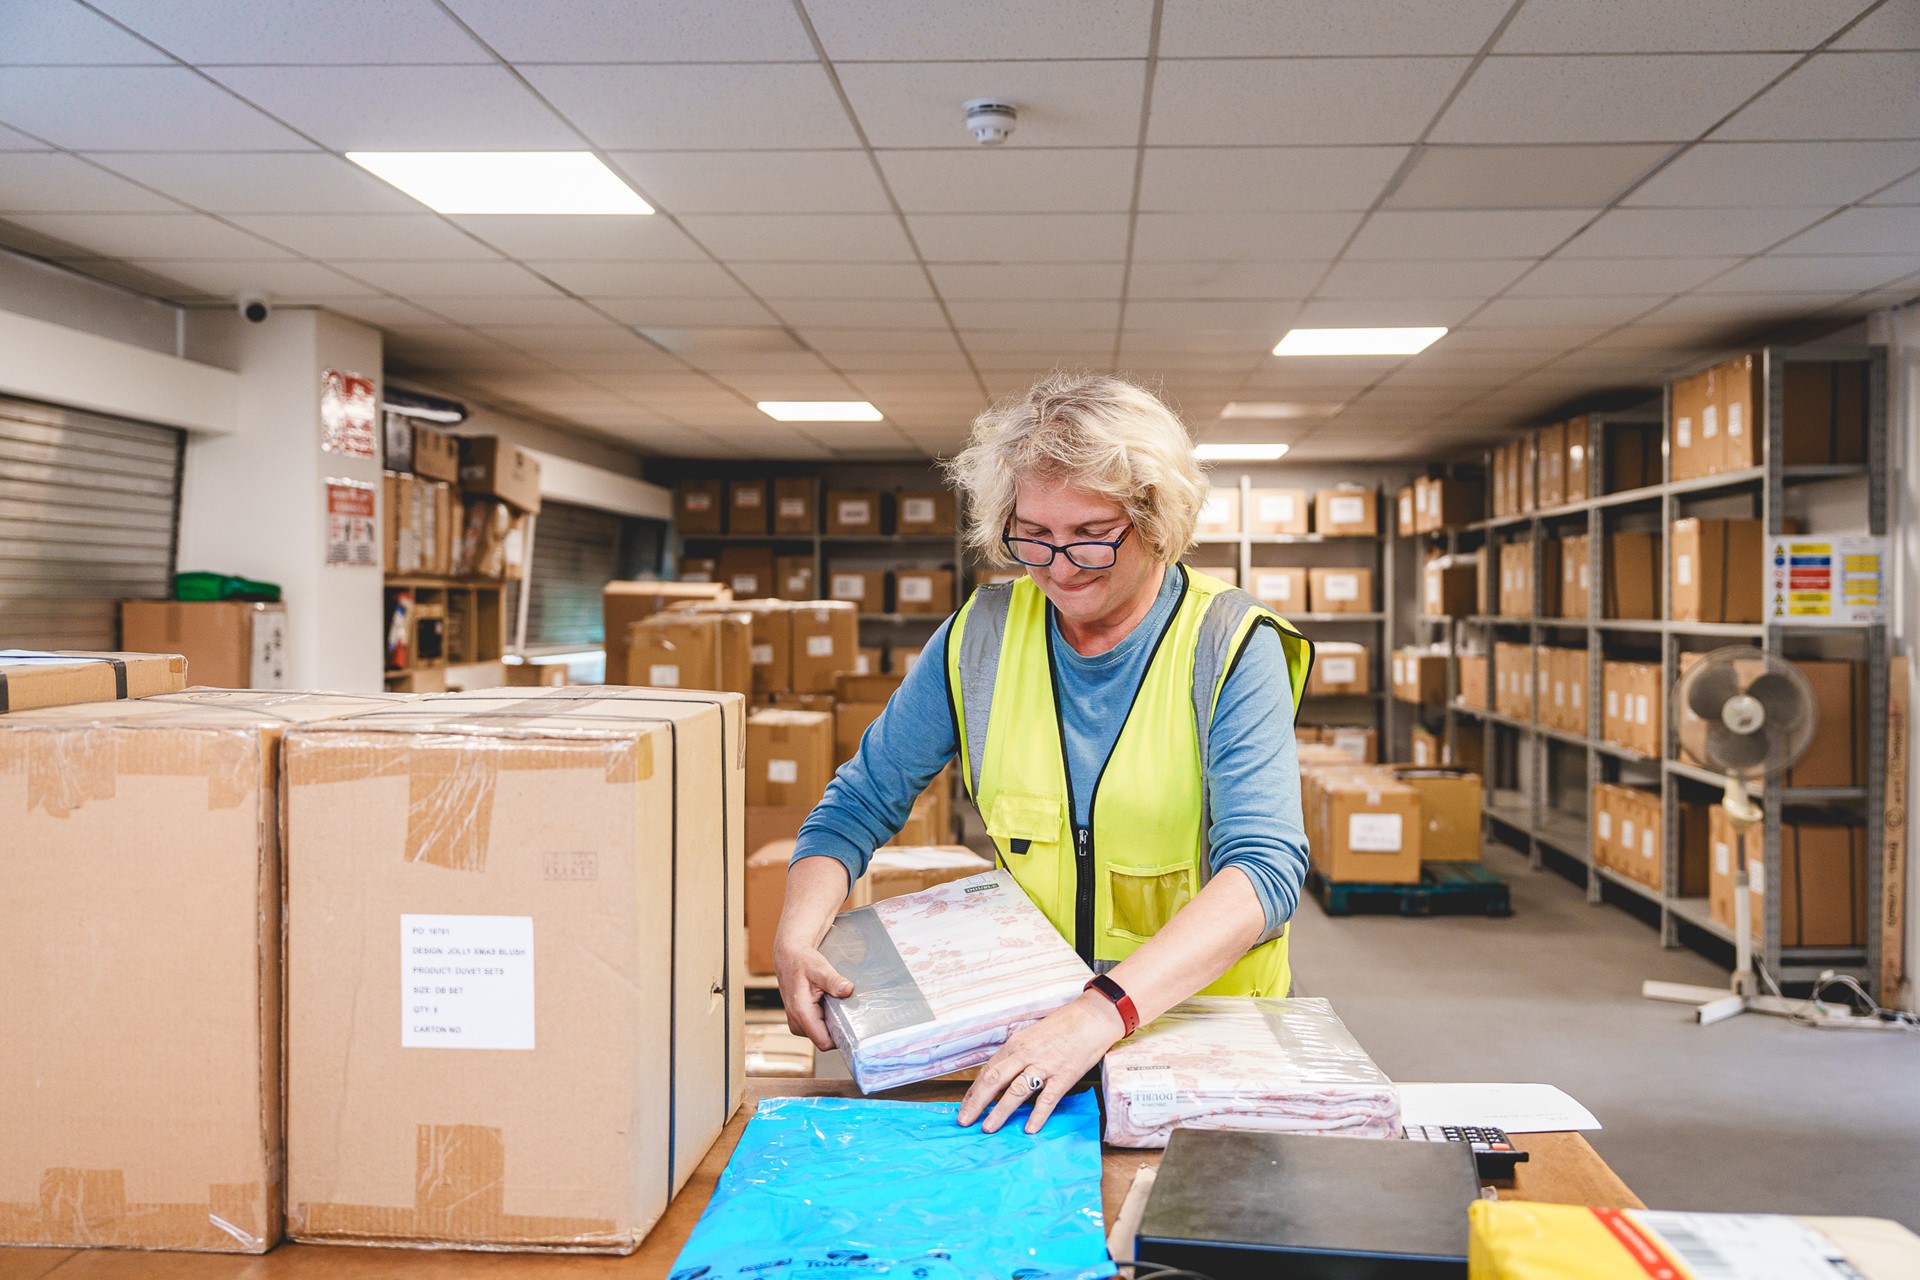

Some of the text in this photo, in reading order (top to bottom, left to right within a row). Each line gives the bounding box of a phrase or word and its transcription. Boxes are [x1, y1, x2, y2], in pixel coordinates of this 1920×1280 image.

[966, 883, 998, 893] DOUBLE
[447, 946, 472, 956] JOLLY
[473, 947, 497, 956] XMAS
[498, 947, 526, 956] BLUSH
[455, 966, 482, 976] DUVET
[484, 967, 505, 976] SETS
[448, 986, 464, 996] SET
[413, 1025, 447, 1034] CARTON
[1136, 1092, 1174, 1102] DOUBLE
